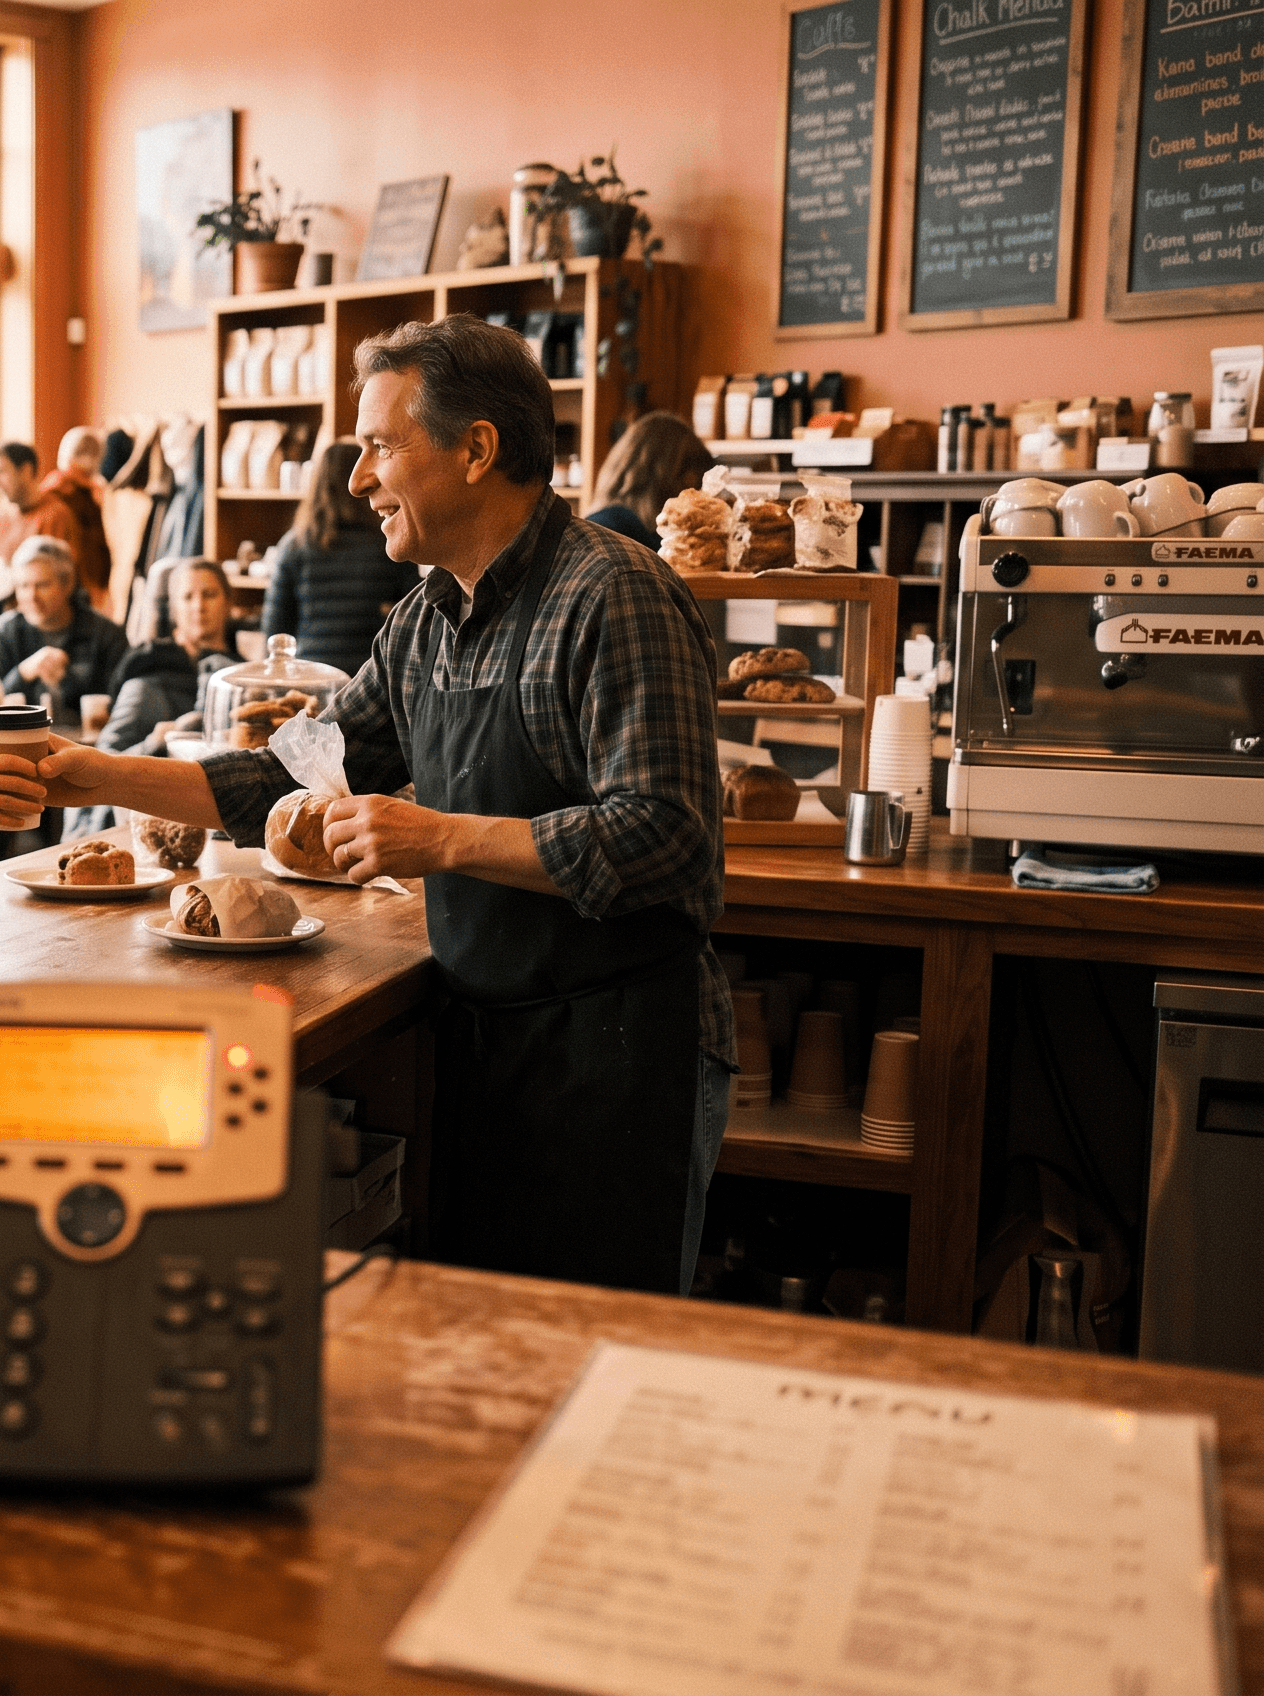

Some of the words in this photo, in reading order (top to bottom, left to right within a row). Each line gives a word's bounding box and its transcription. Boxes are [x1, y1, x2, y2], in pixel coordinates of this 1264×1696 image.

[934, 0, 989, 37] Chalk
[1174, 547, 1254, 559] FAEMA
[1149, 628, 1264, 646] FAEMA
